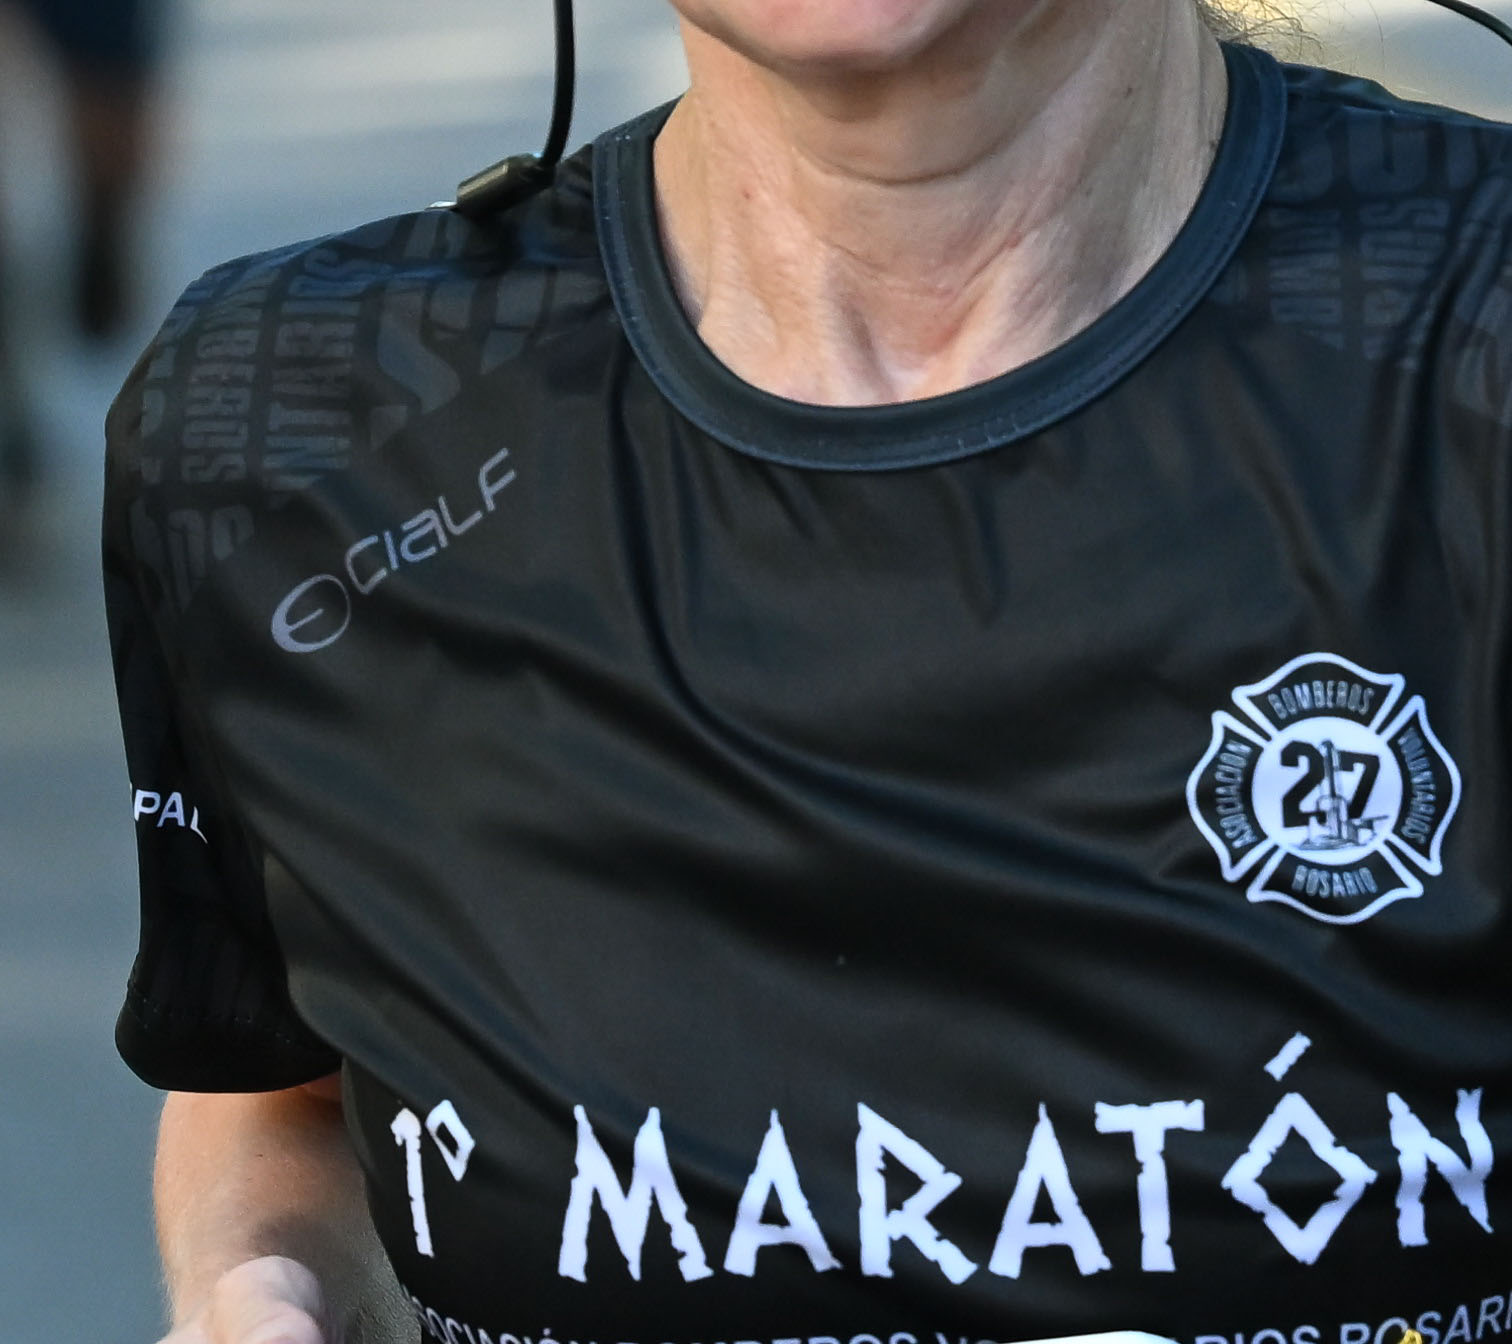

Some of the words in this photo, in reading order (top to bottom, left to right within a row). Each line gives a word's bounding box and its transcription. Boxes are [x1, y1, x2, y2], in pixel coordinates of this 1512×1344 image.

[1267, 680, 1376, 720] BOMBEROS
[1280, 739, 1382, 830] 27
[1291, 864, 1379, 899] ROSARIO
[558, 1033, 1494, 1285] MARATÓN
